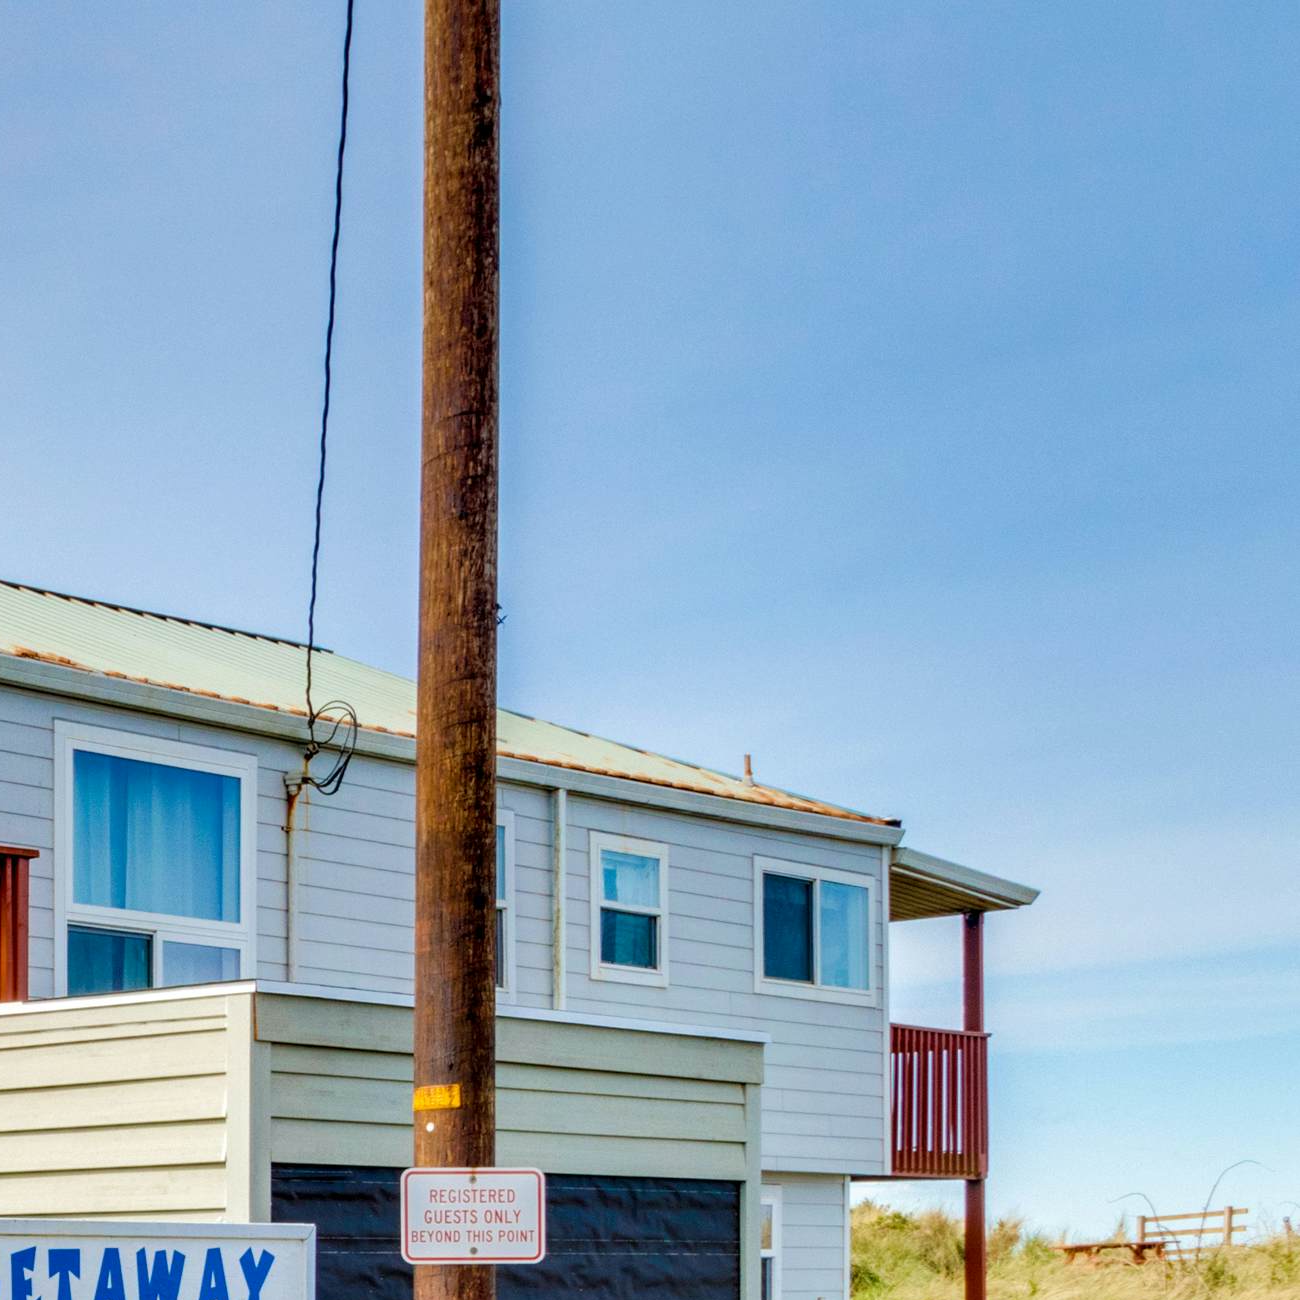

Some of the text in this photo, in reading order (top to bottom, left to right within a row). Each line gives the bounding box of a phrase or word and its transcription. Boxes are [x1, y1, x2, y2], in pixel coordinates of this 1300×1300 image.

[429, 1189, 516, 1204] REGISTERED
[424, 1209, 522, 1224] GUESTS ONLY
[411, 1230, 535, 1243] BEYOND THIS POINT
